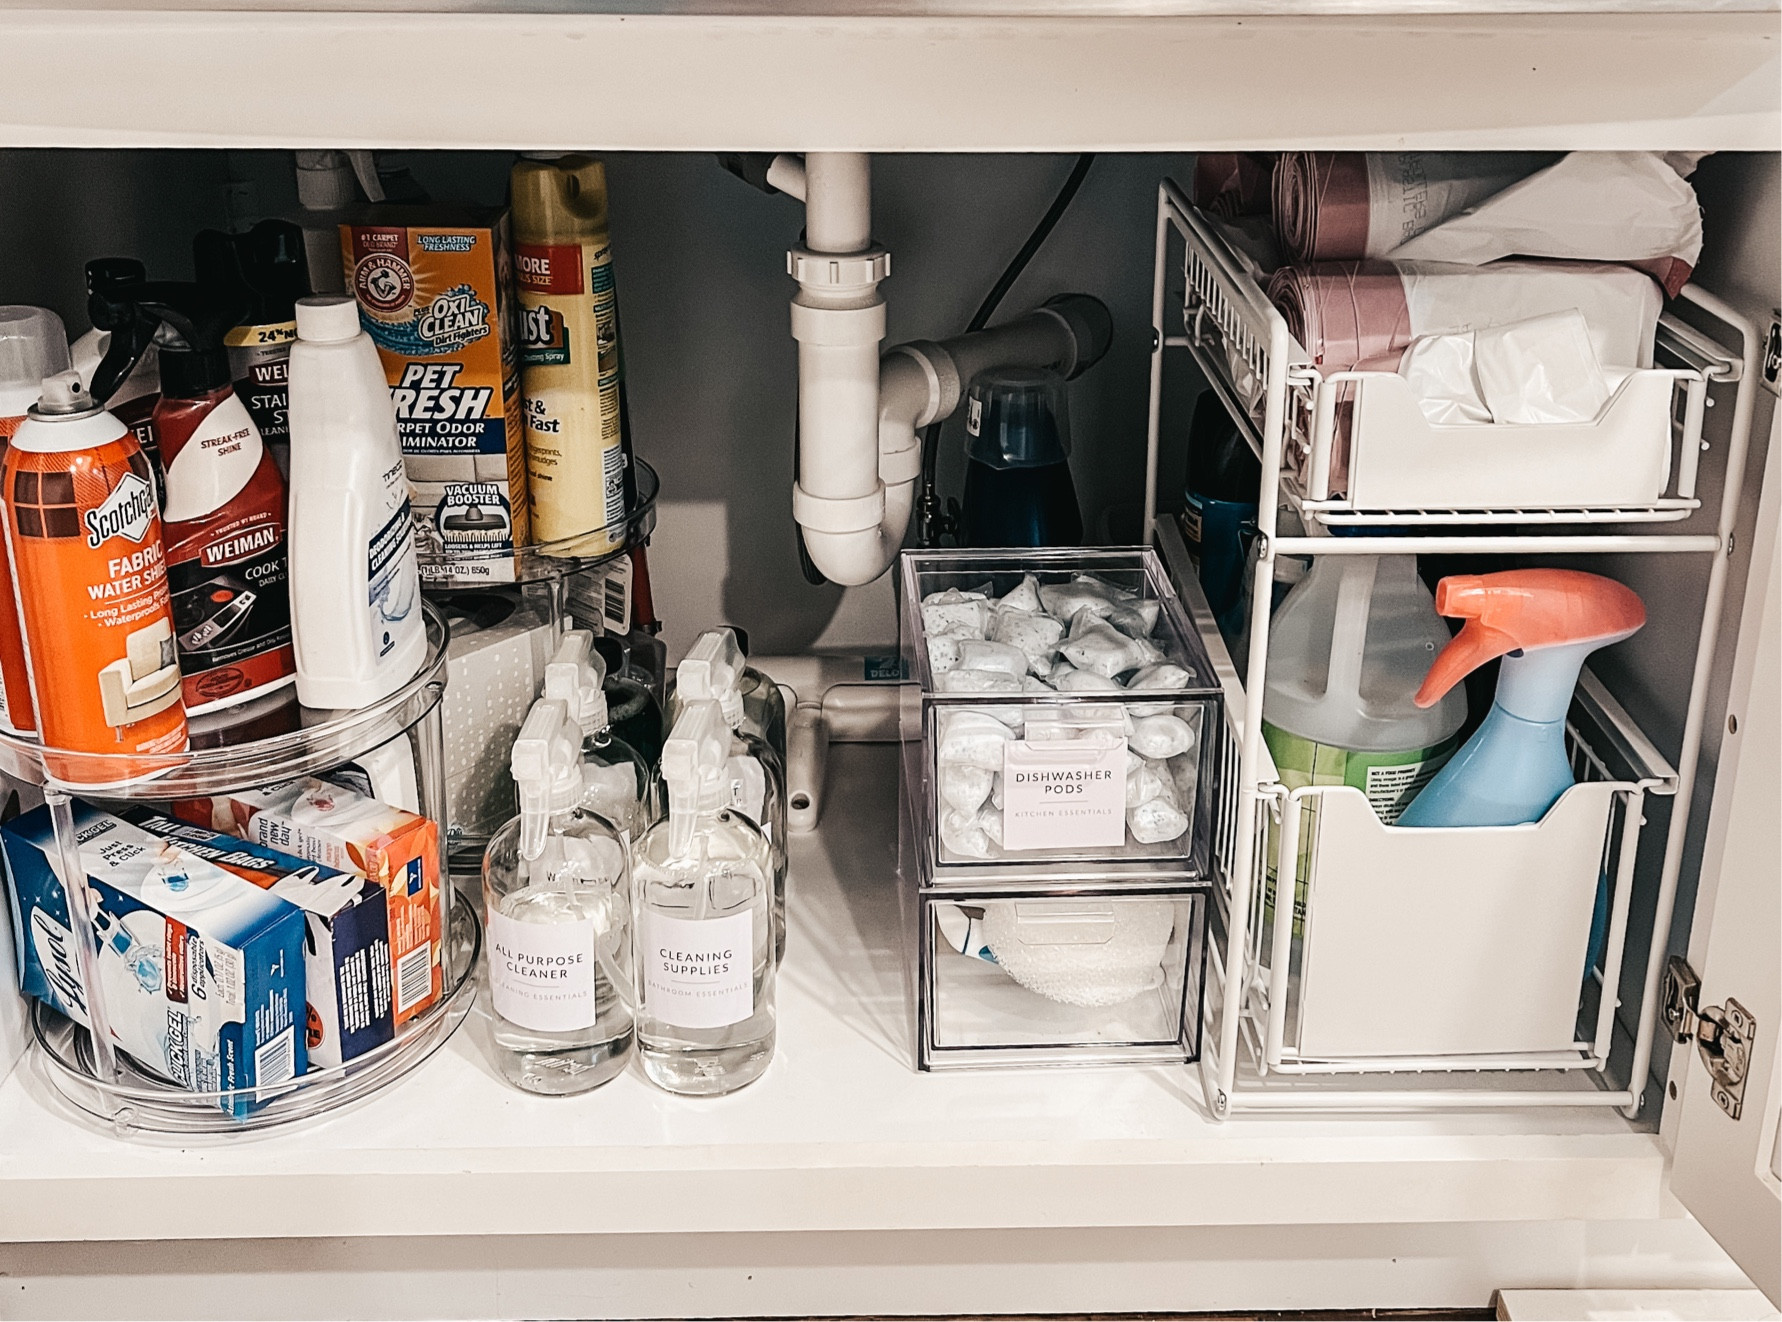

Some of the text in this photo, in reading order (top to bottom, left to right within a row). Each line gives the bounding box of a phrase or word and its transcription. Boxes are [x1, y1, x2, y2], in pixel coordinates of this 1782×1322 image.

[417, 236, 476, 244] LONG LASTING
[424, 243, 471, 251] FRESHNESS
[359, 258, 410, 290] ARM & HAMMER
[433, 296, 468, 319] OXI
[421, 310, 480, 338] CLEAN
[435, 326, 488, 346] Dirt Fighters
[545, 353, 565, 362] Spray
[401, 364, 460, 388] PET
[391, 388, 491, 419] RESH
[535, 400, 546, 415] &
[436, 421, 484, 434] ODOR
[530, 414, 560, 433] Fast
[200, 427, 251, 450] STREAK-FREE
[217, 443, 243, 457] SHINE
[446, 484, 498, 495] VACUUM
[447, 494, 500, 506] BOOSTER
[206, 527, 275, 563] WEIMAN
[107, 541, 163, 579] FABRIC
[245, 560, 279, 580] COOK
[87, 574, 142, 600] WATER
[94, 607, 118, 619] Long
[120, 595, 153, 613] Lasting
[1016, 770, 1112, 783] DISHWASHER
[1045, 784, 1084, 794] PODS
[1015, 808, 1112, 818] KITCHEN ESSENTIALS
[139, 815, 182, 833] TALL
[270, 821, 279, 845] new
[100, 841, 123, 855] Just
[102, 844, 134, 861] Press
[217, 851, 276, 869] BAGS
[495, 943, 584, 967] ALL PURPOSE
[659, 948, 733, 962] CLEANING
[33, 914, 89, 1017] Lysol
[506, 961, 568, 979] CLEANER
[663, 963, 730, 976] SUPPLIES
[191, 983, 206, 1000] 6
[533, 990, 588, 1001] ESSENTIALS
[696, 981, 748, 997] ESSENTIALS
[226, 1062, 234, 1083] Fresh
